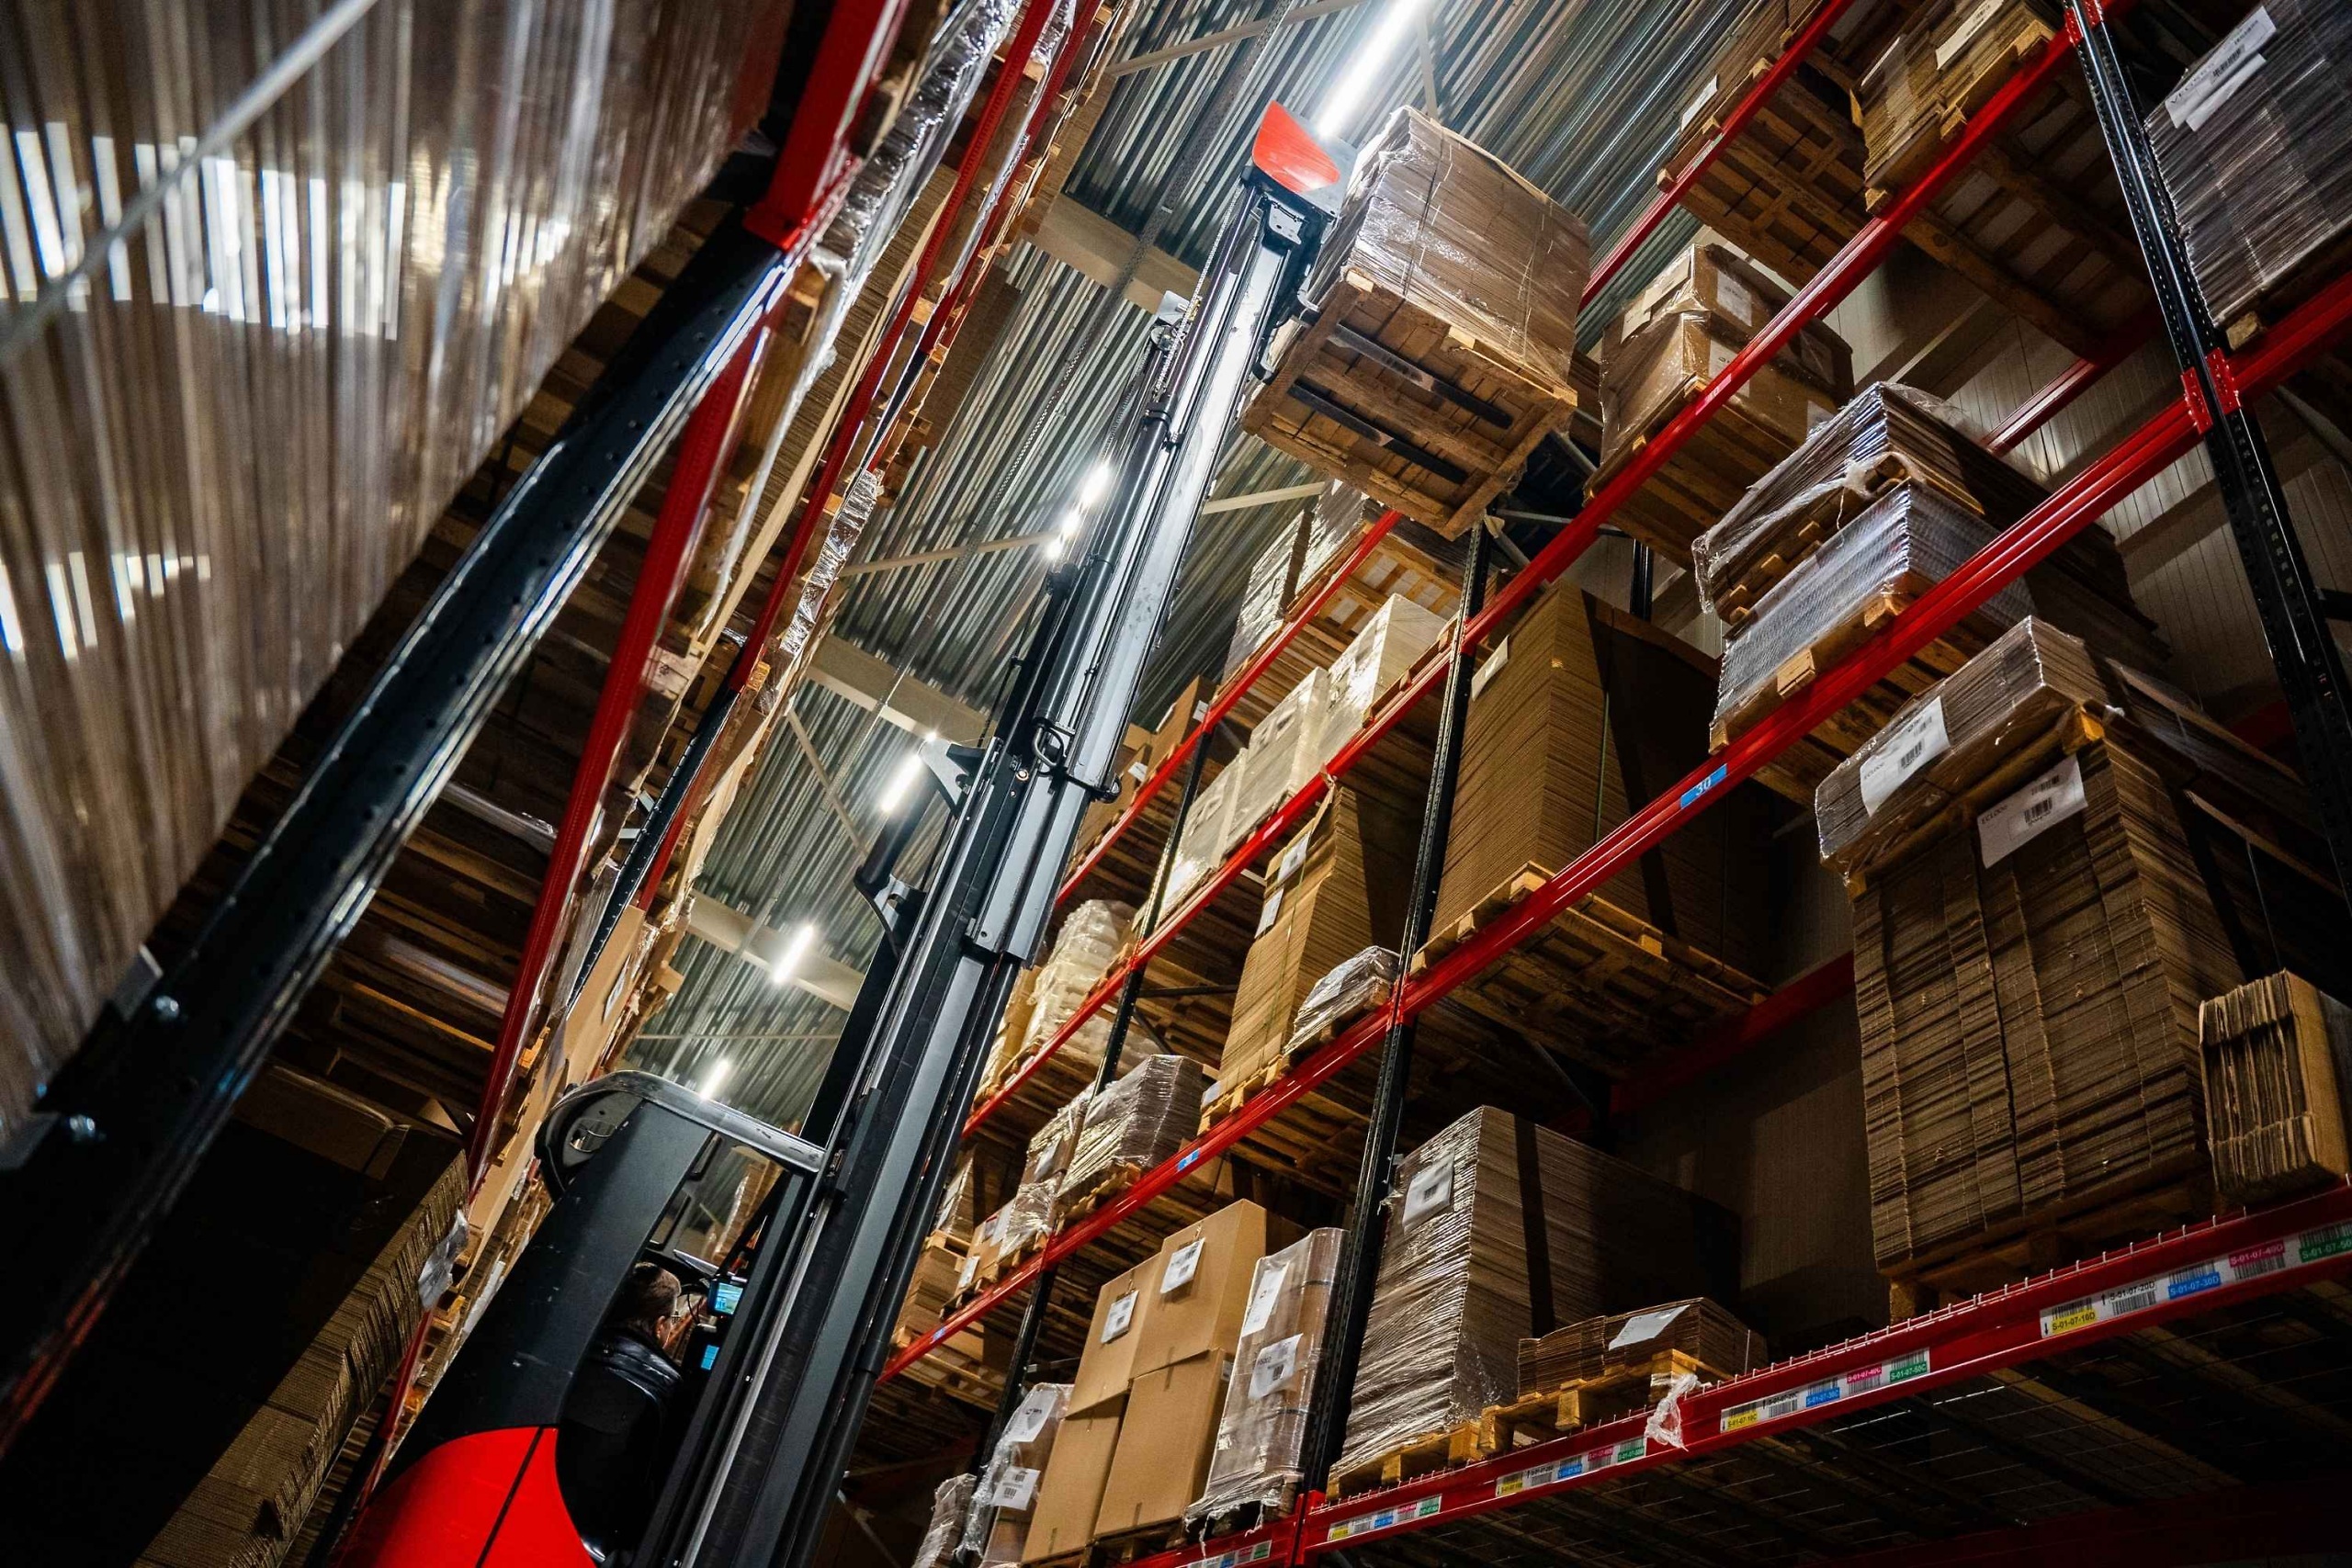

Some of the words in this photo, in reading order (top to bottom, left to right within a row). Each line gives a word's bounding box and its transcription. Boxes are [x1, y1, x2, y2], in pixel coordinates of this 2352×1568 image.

[1695, 777, 1711, 796] 30
[2230, 1245, 2283, 1265] S-01-07-40D
[2109, 1280, 2155, 1301] S-01-07-20D
[2170, 1275, 2219, 1296] S-01-07-30D
[2052, 1312, 2095, 1331] S-01-07-10D
